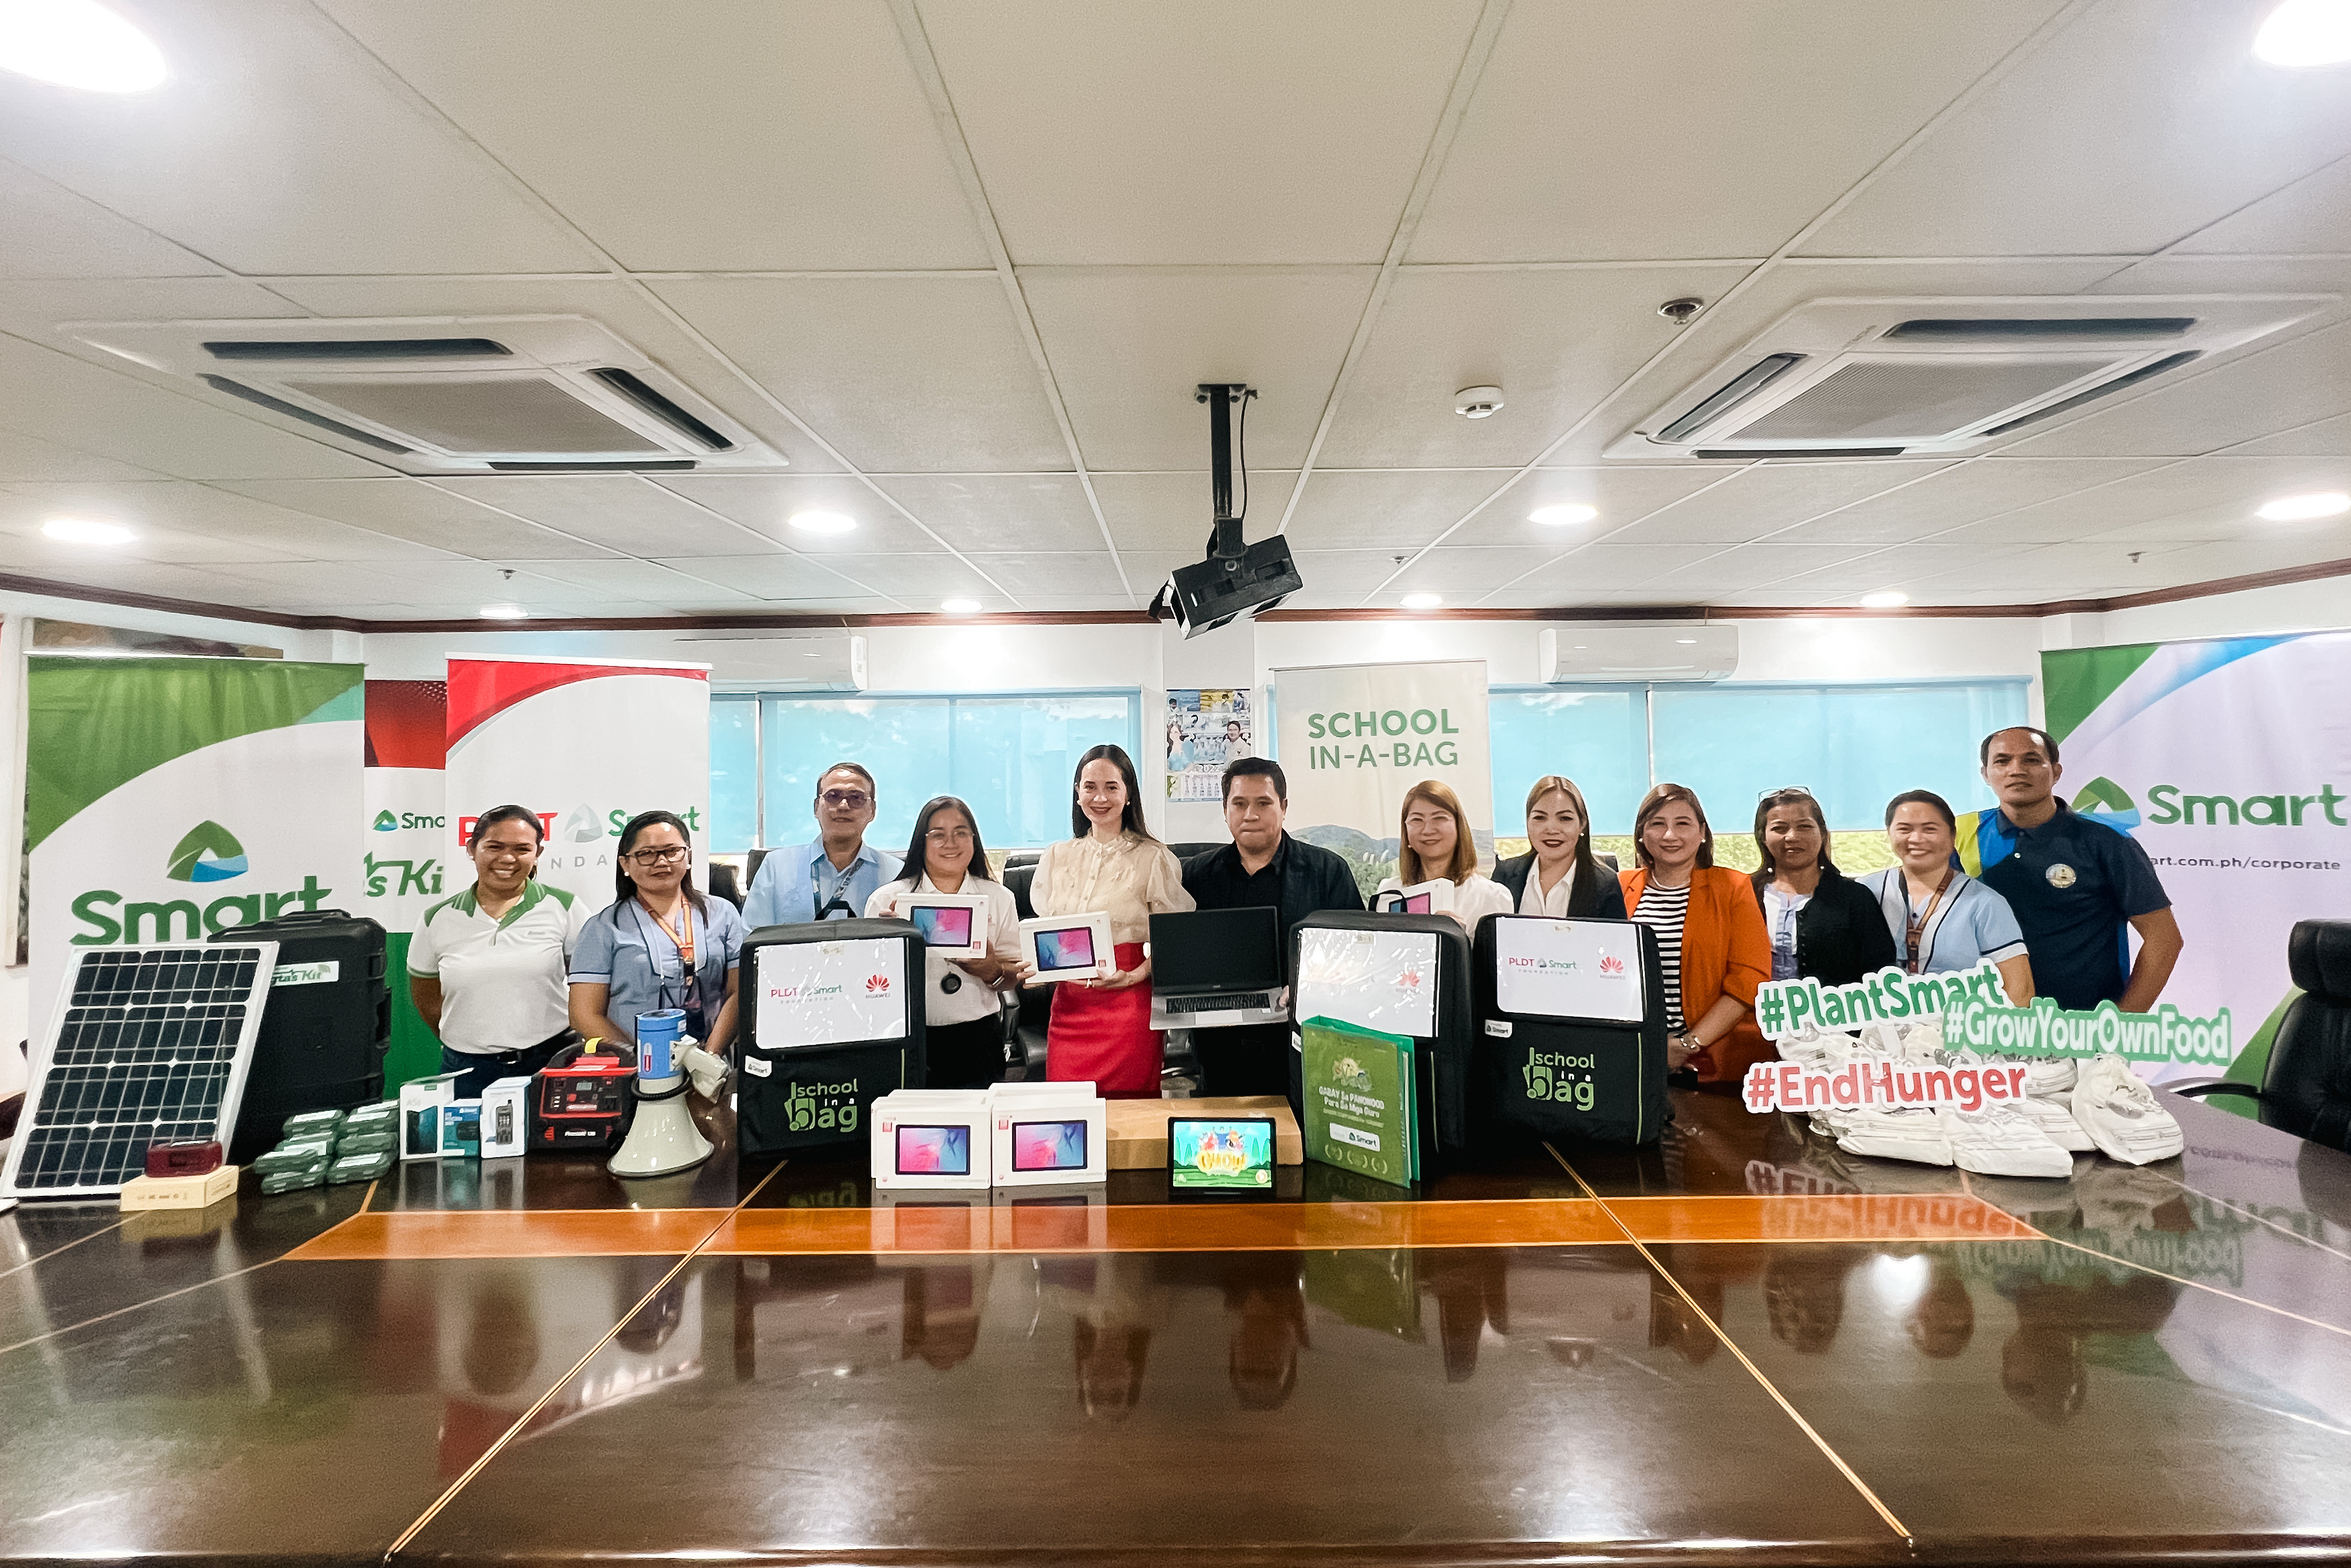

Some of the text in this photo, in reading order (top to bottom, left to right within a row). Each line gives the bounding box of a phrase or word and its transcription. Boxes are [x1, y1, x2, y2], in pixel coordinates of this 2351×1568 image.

[1308, 709, 1459, 738] SCHOOL
[1310, 741, 1458, 769] IN-A-BAG
[2147, 784, 2348, 826] Smart
[458, 812, 558, 846] PT
[2149, 856, 2340, 870] art.com.ph/corporate
[1509, 957, 1577, 969] PLDT Smart
[1762, 965, 2004, 1034] #PlantSmart
[1946, 1001, 2229, 1058] #GrowYourOwnFood
[1535, 1052, 1595, 1069] school
[798, 1079, 858, 1096] school
[1523, 1062, 1595, 1111] bag
[1561, 1071, 1575, 1080] in
[1748, 1062, 2026, 1110] #EndHunger
[784, 1097, 858, 1132] bag
[824, 1098, 838, 1106] in
[1356, 1134, 1377, 1147] Smart
